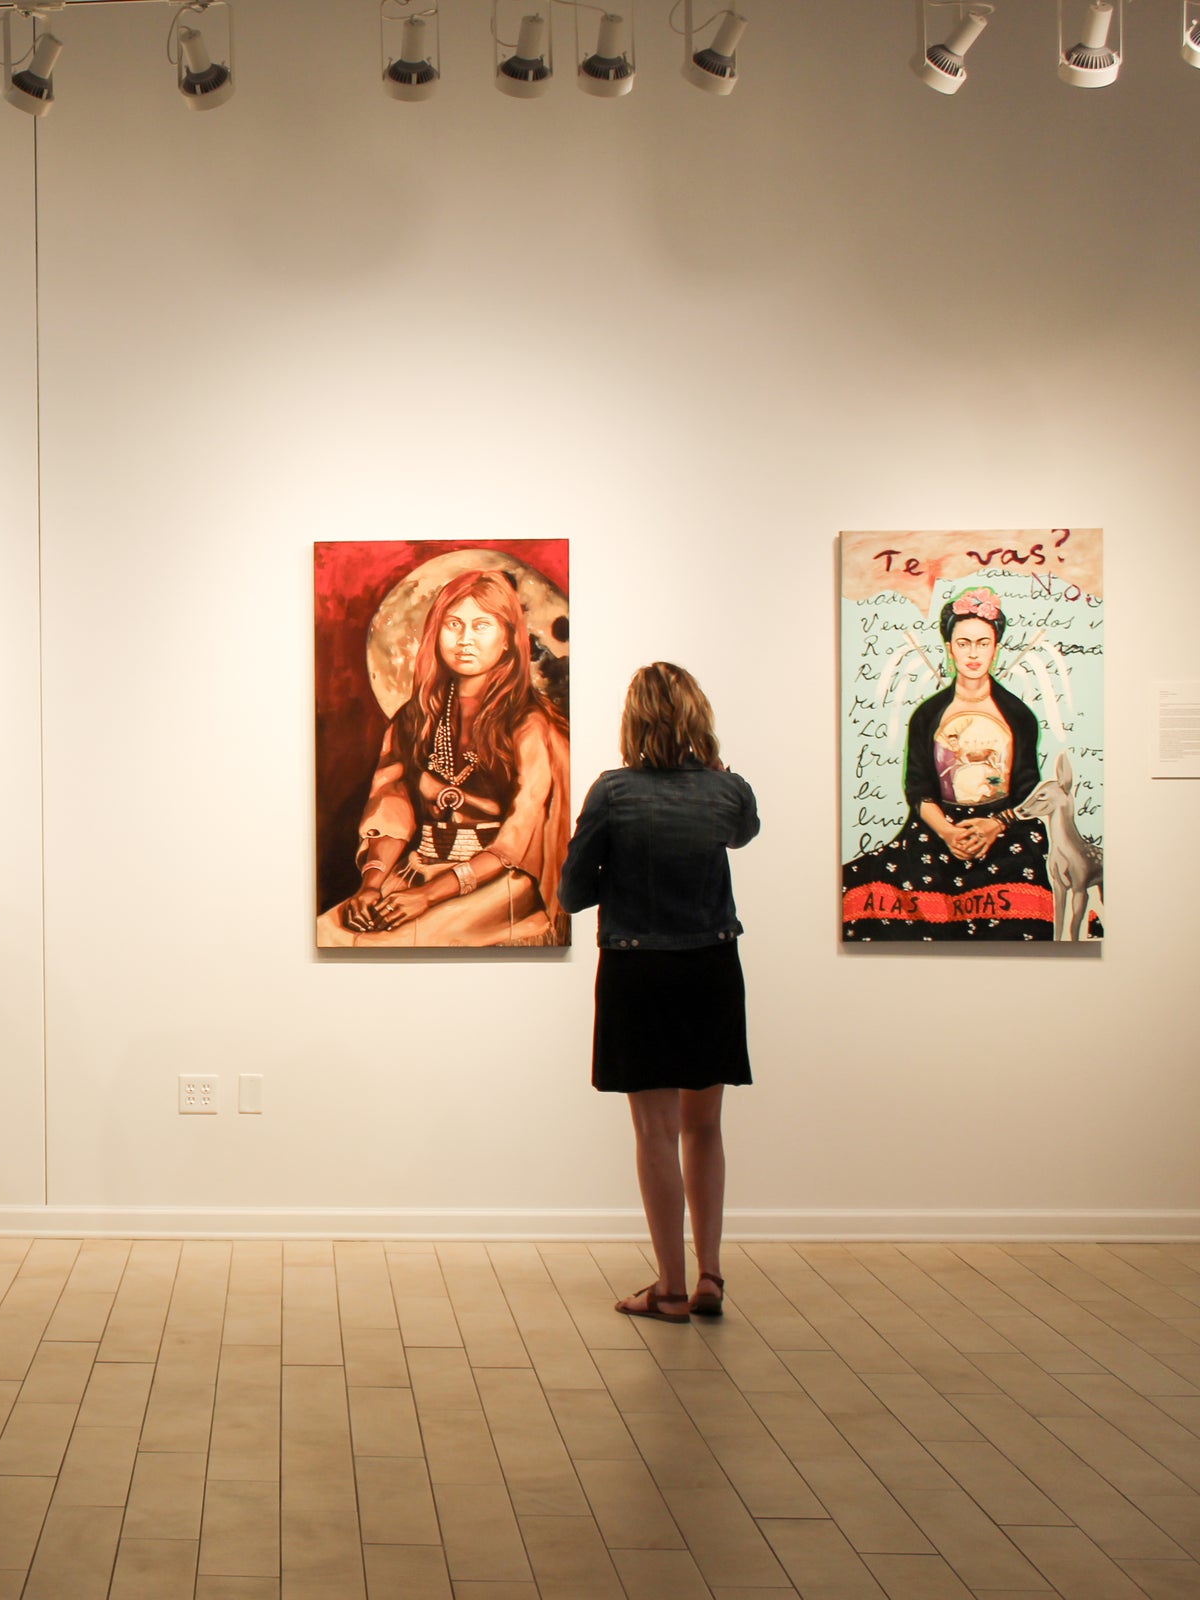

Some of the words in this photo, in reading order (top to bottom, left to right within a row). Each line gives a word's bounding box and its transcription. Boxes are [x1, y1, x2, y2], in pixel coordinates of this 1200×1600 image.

[873, 549, 924, 576] Te
[966, 529, 1070, 566] vas?
[863, 892, 918, 914] ALAS
[953, 890, 1011, 916] ROTAS
